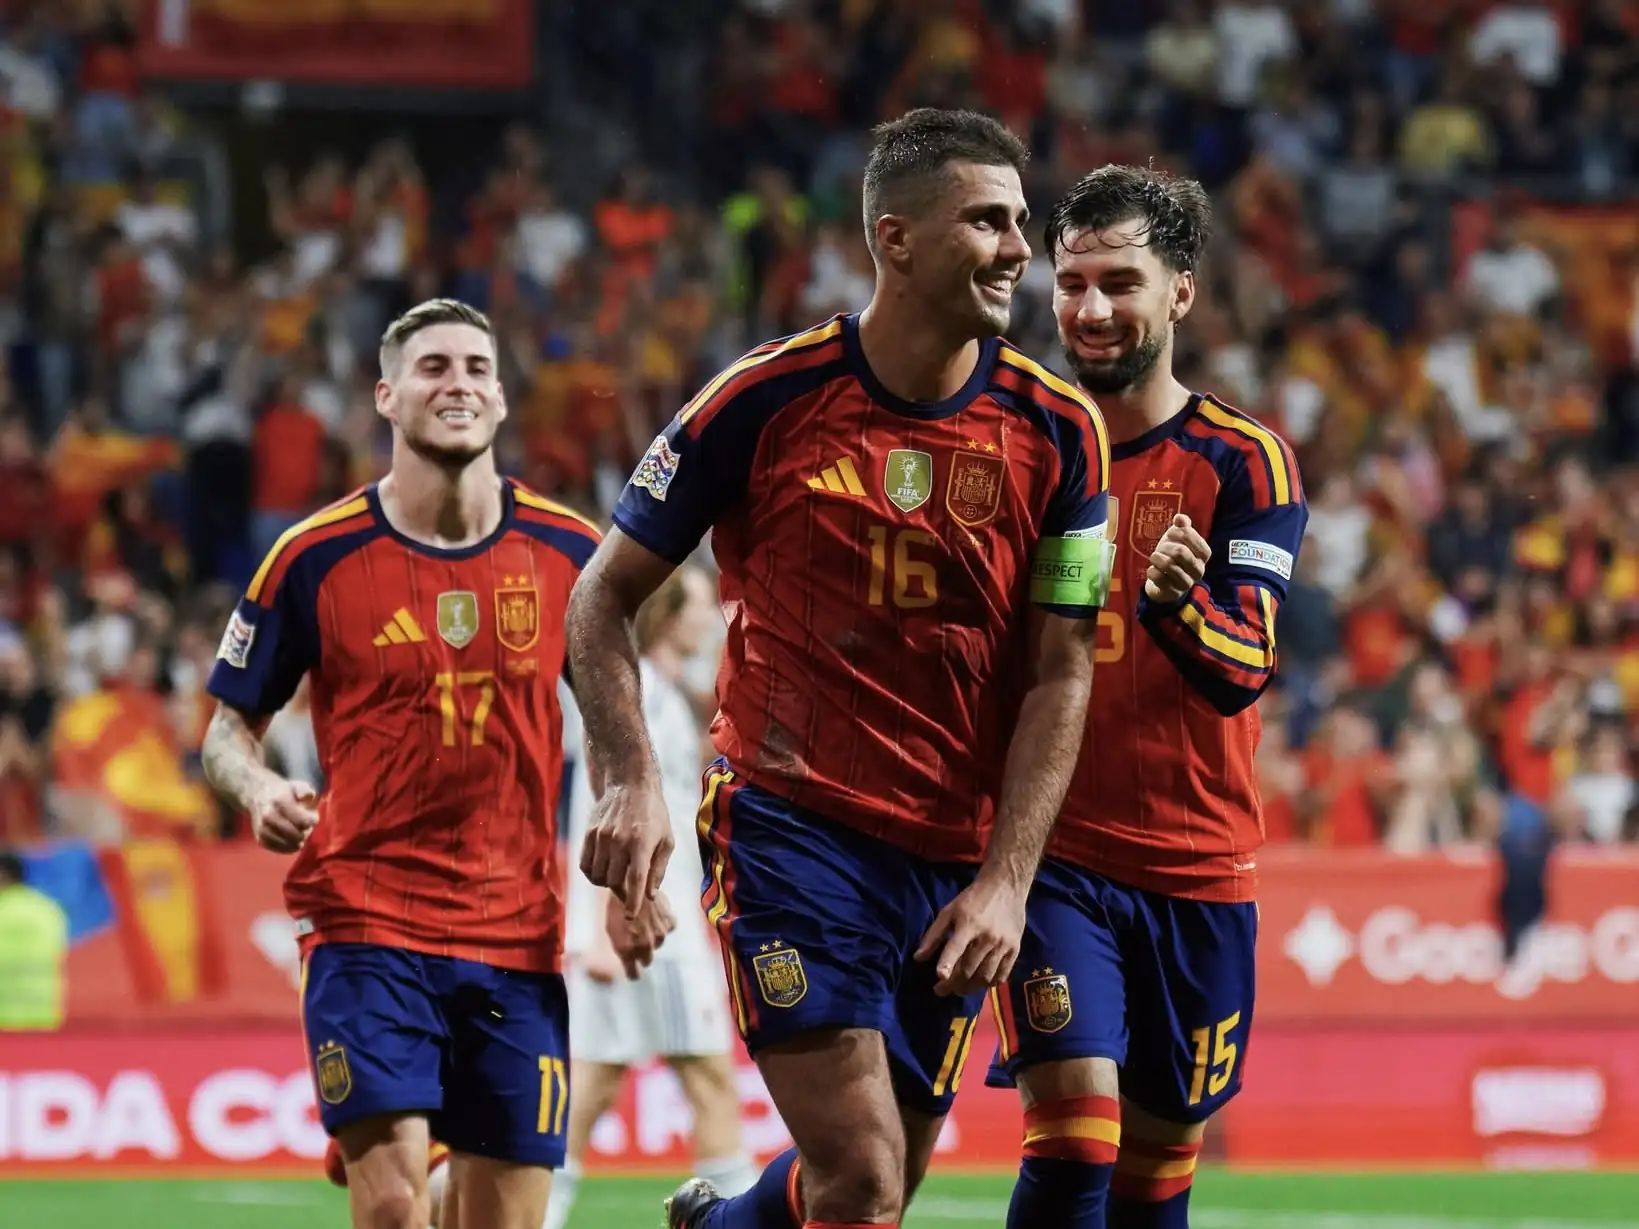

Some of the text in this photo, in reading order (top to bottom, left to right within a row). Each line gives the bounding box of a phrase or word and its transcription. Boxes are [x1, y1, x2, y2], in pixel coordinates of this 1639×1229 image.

[897, 487, 918, 497] FIFA
[868, 525, 938, 609] 16
[435, 670, 495, 746] 17
[1189, 1010, 1241, 1105] 15
[0, 1069, 182, 1161] DA
